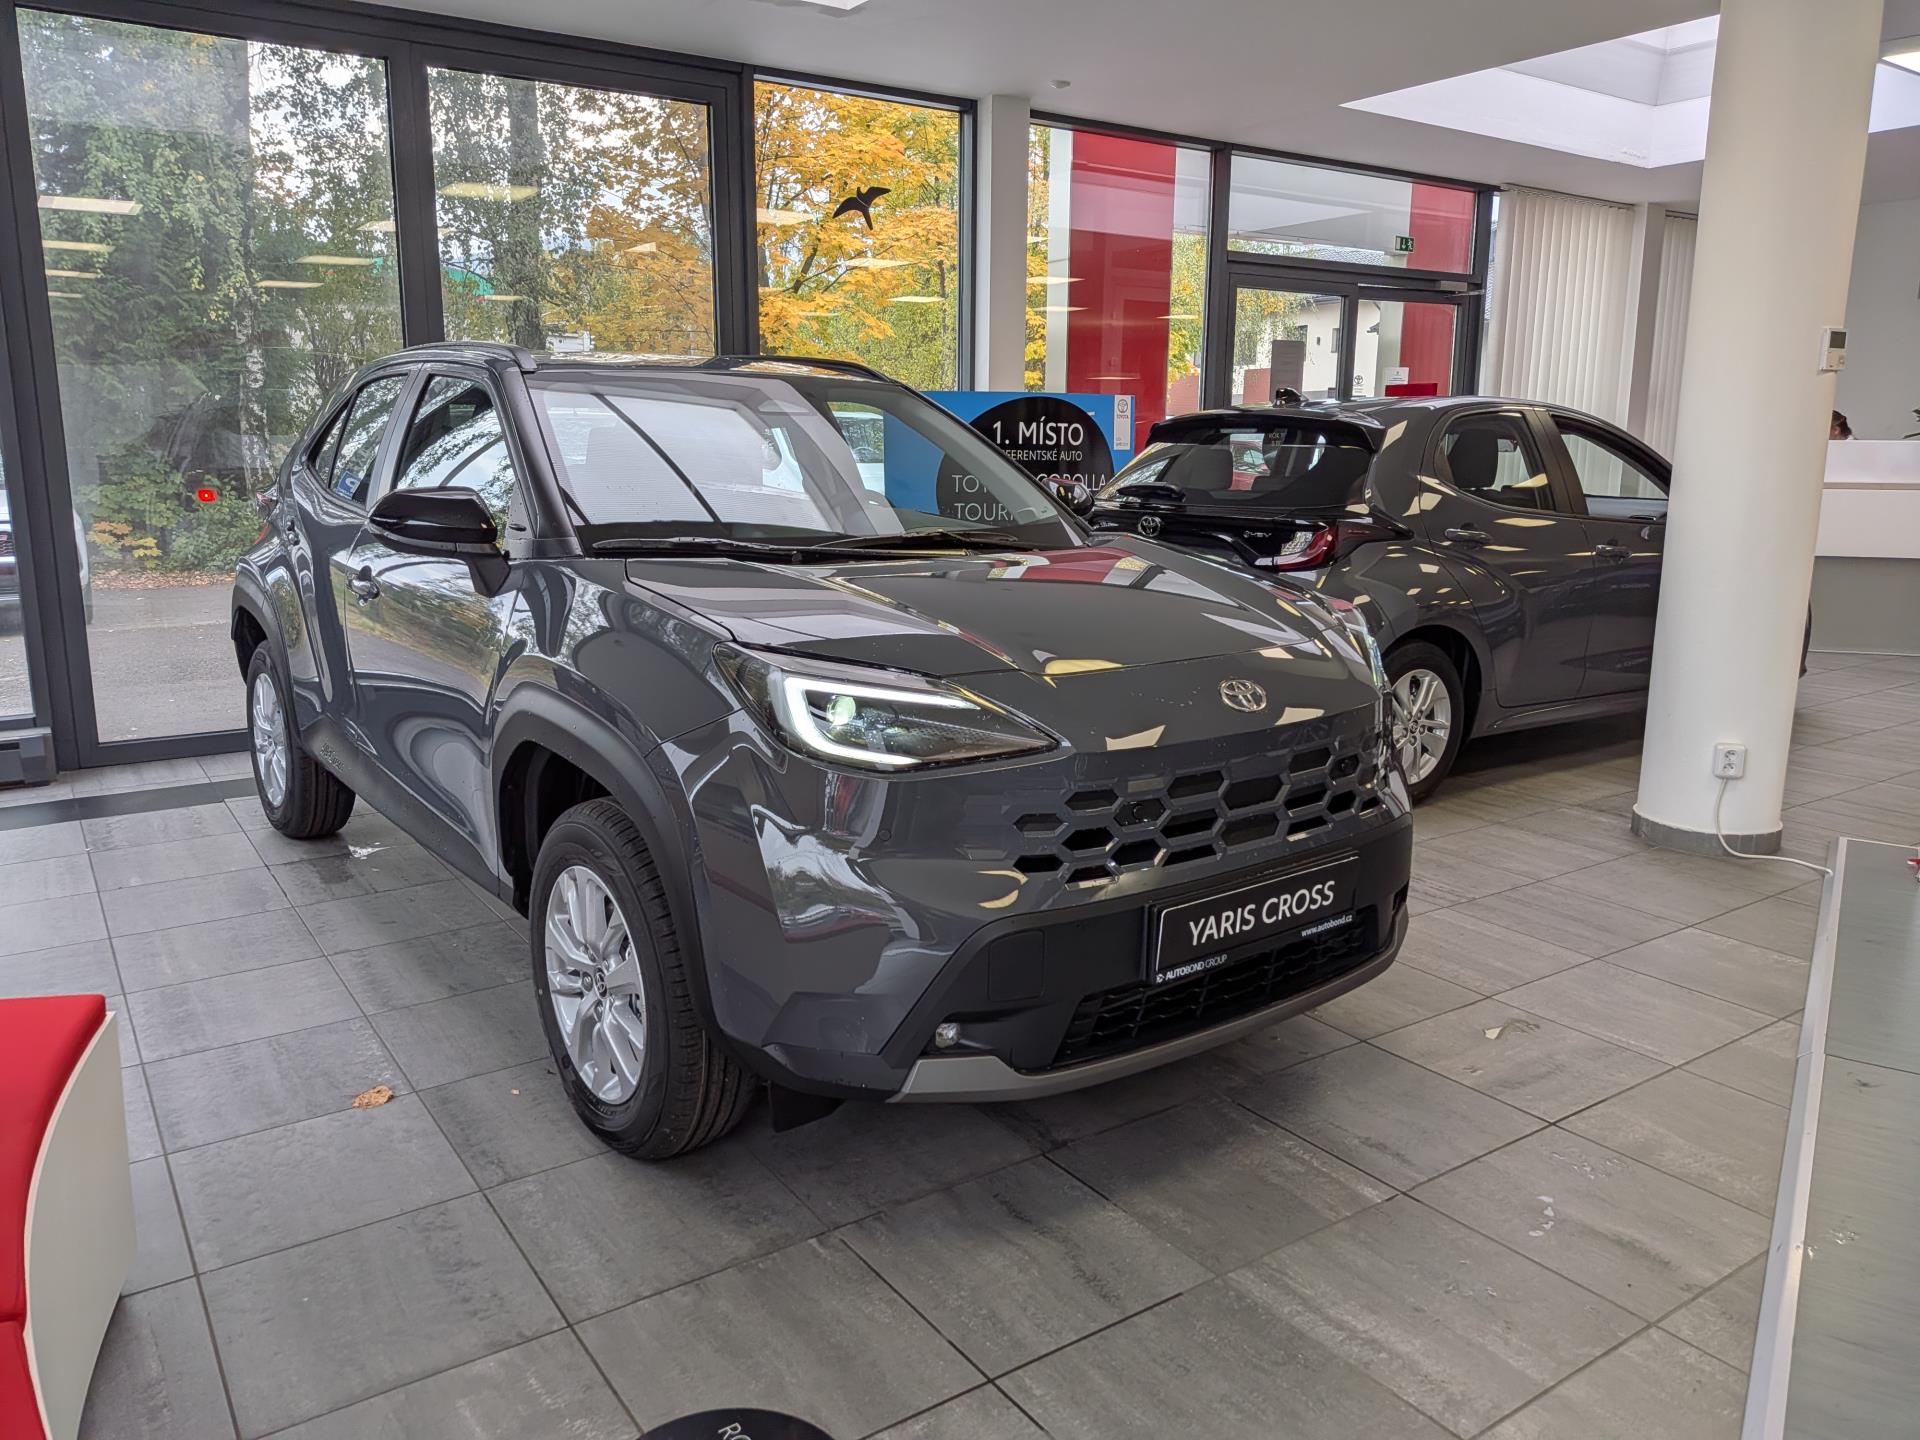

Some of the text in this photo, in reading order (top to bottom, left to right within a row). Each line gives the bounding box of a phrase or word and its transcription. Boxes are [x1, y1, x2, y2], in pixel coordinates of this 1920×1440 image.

[993, 416, 1084, 446] 1. MÍSTO
[1002, 448, 1083, 461] FERENTSKÉ AUTO
[951, 474, 987, 493] TO
[1188, 880, 1336, 947] YARIS CROSS
[1301, 914, 1353, 937] www.autobond.cz
[1165, 953, 1228, 981] AUTOBOND GROUP
